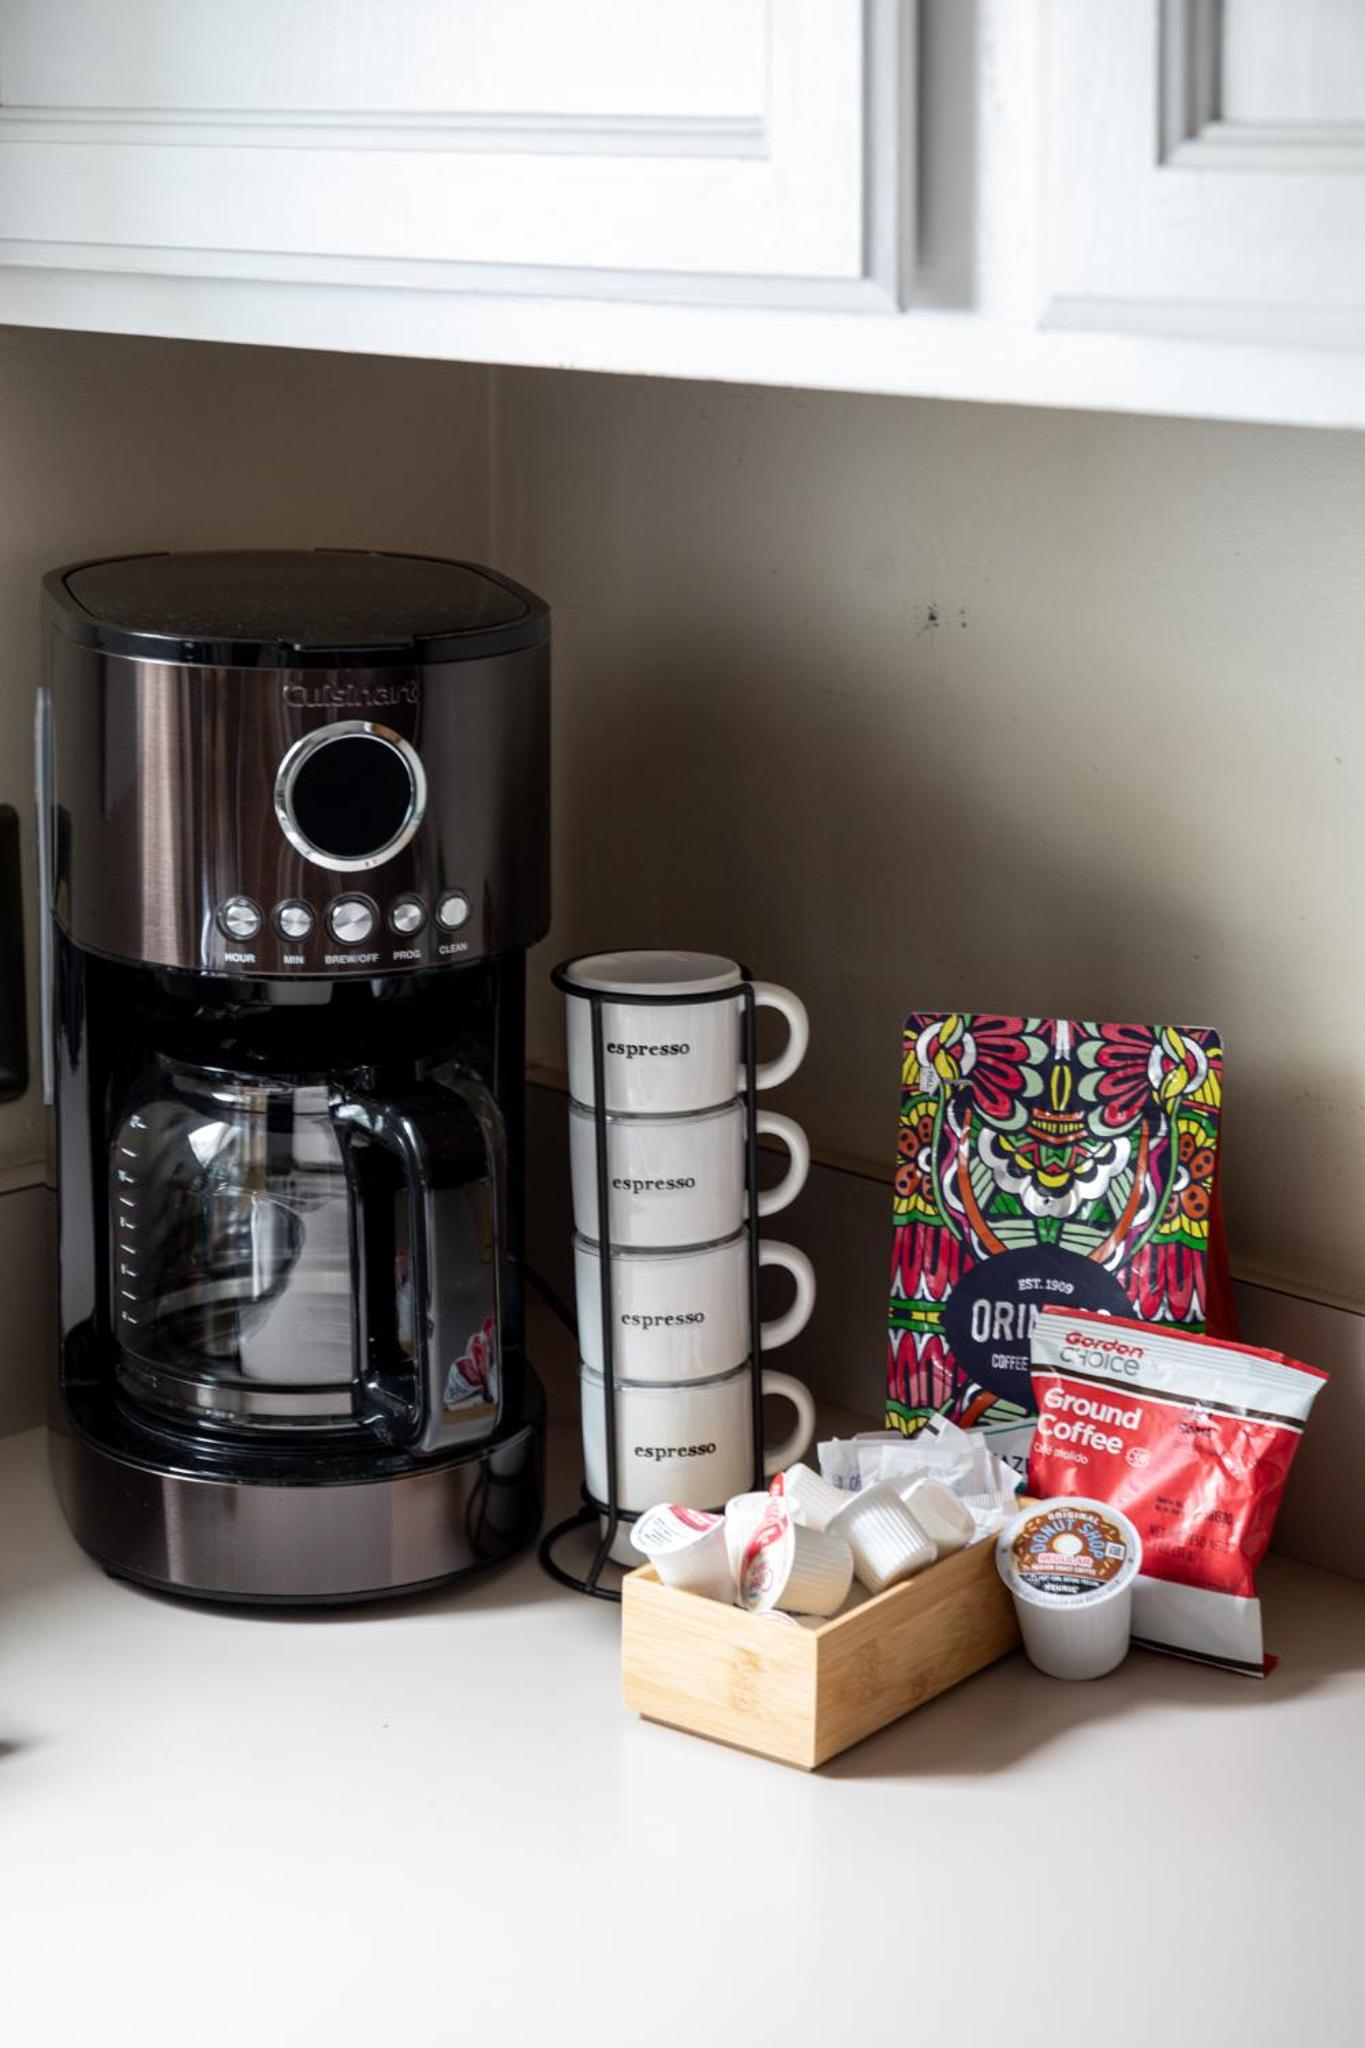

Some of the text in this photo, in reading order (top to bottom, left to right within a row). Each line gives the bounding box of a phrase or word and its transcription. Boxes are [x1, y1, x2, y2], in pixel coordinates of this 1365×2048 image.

[393, 949, 421, 960] PROG
[439, 942, 468, 955] CLEAN
[224, 952, 256, 963] HOUR
[283, 954, 304, 965] MIN
[325, 953, 380, 965] BREW/OFF
[606, 1042, 691, 1059] espresso
[612, 1177, 696, 1194] espresso
[620, 1312, 705, 1330] espresso
[1065, 1332, 1144, 1359] Gordon
[991, 1353, 1028, 1371] COFFEE
[1044, 1387, 1143, 1430] Ground
[1037, 1413, 1124, 1455] Coffee
[634, 1442, 717, 1461] espresso
[1029, 1519, 1075, 1554] DONUT
[1077, 1522, 1106, 1559] SHOP
